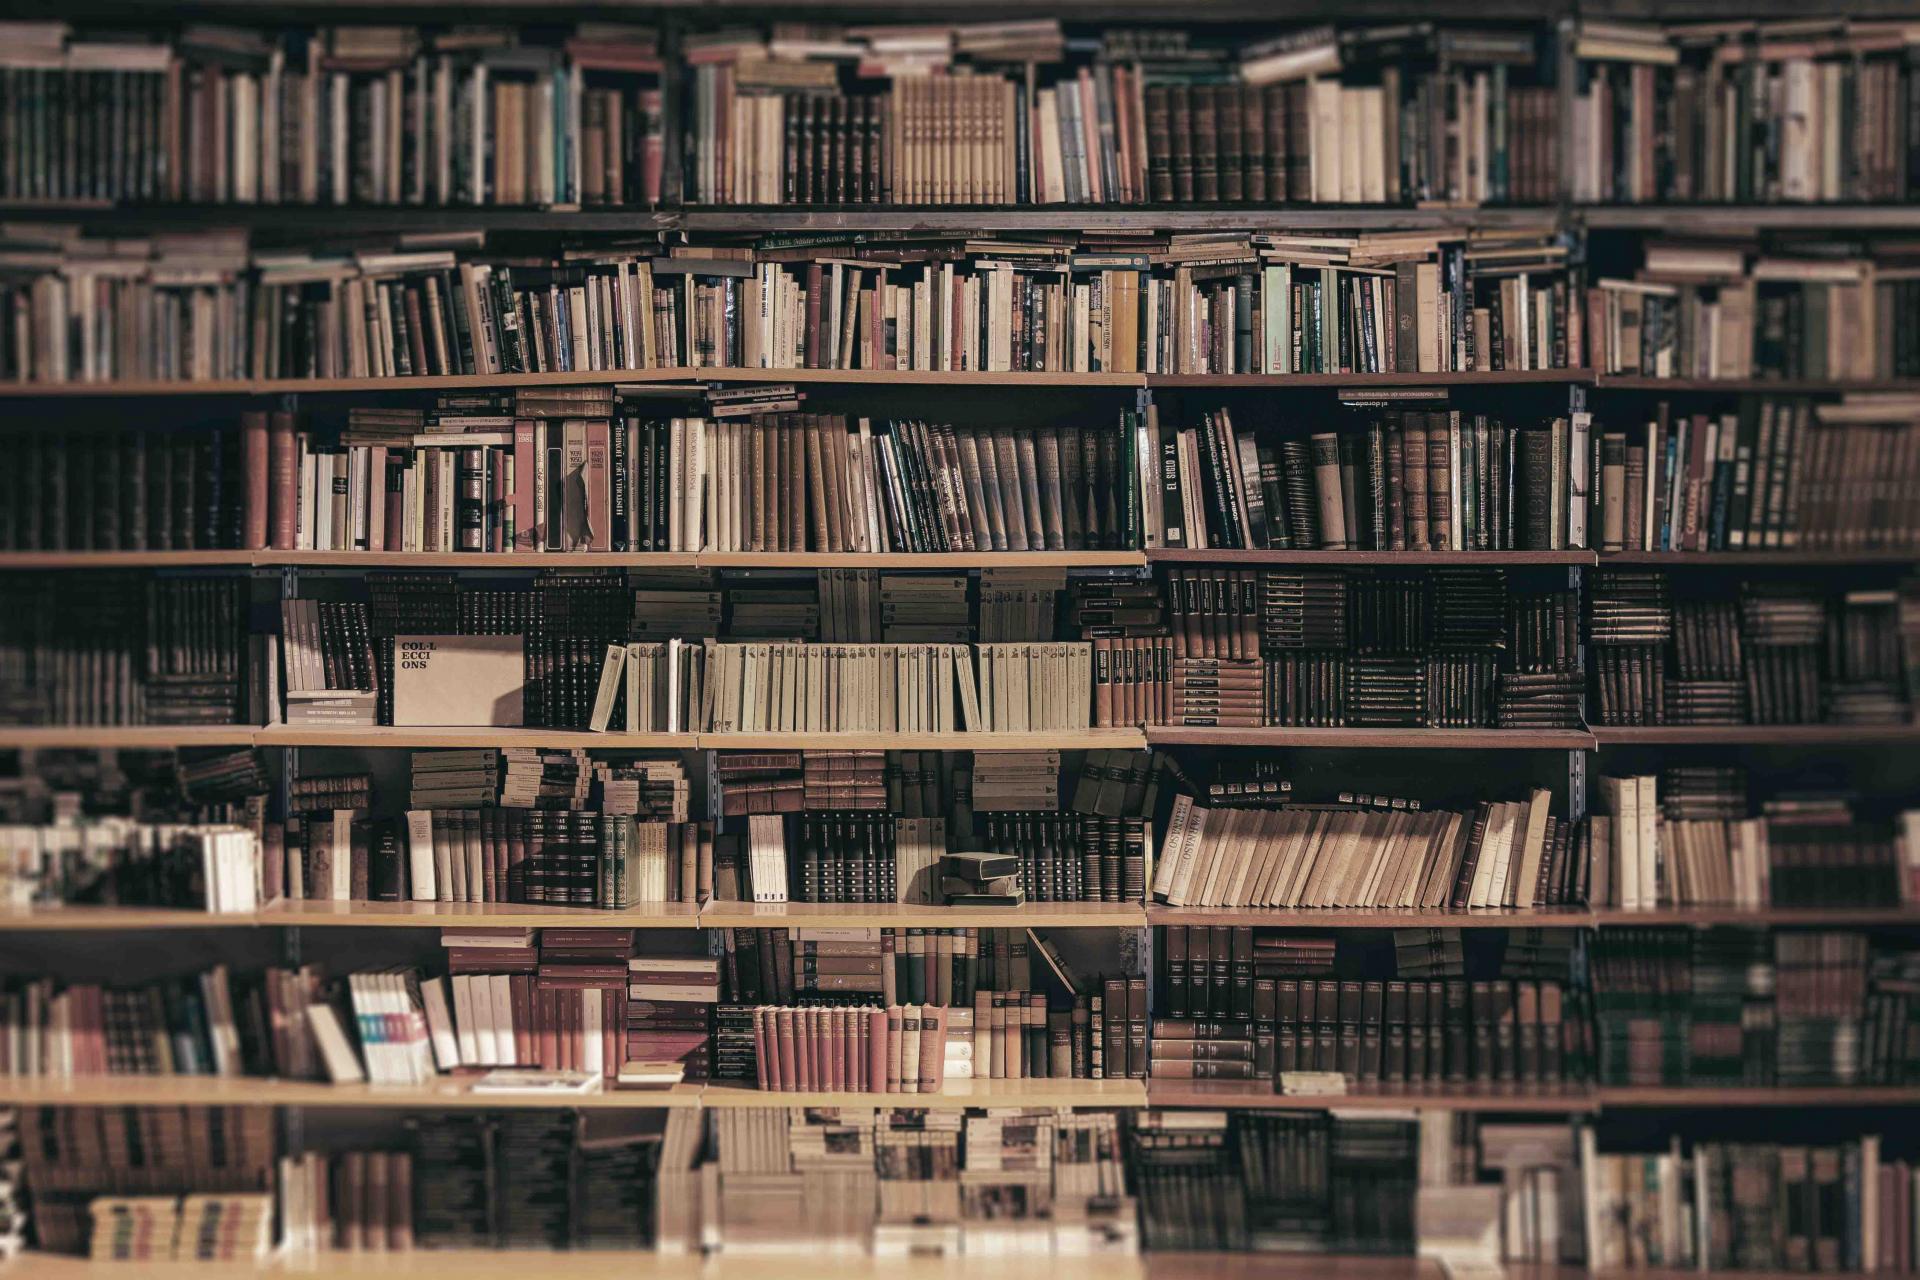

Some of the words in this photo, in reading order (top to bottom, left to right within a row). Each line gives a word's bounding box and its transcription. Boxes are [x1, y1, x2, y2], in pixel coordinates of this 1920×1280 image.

[1164, 444, 1175, 455] XX
[1165, 459, 1176, 479] SIGLO
[1166, 482, 1177, 491] EL
[401, 642, 437, 651] COL·L
[401, 651, 430, 660] ECCI
[401, 660, 427, 669] ONS
[1168, 801, 1188, 849] PARNASO
[1182, 815, 1201, 860] PARNASO
